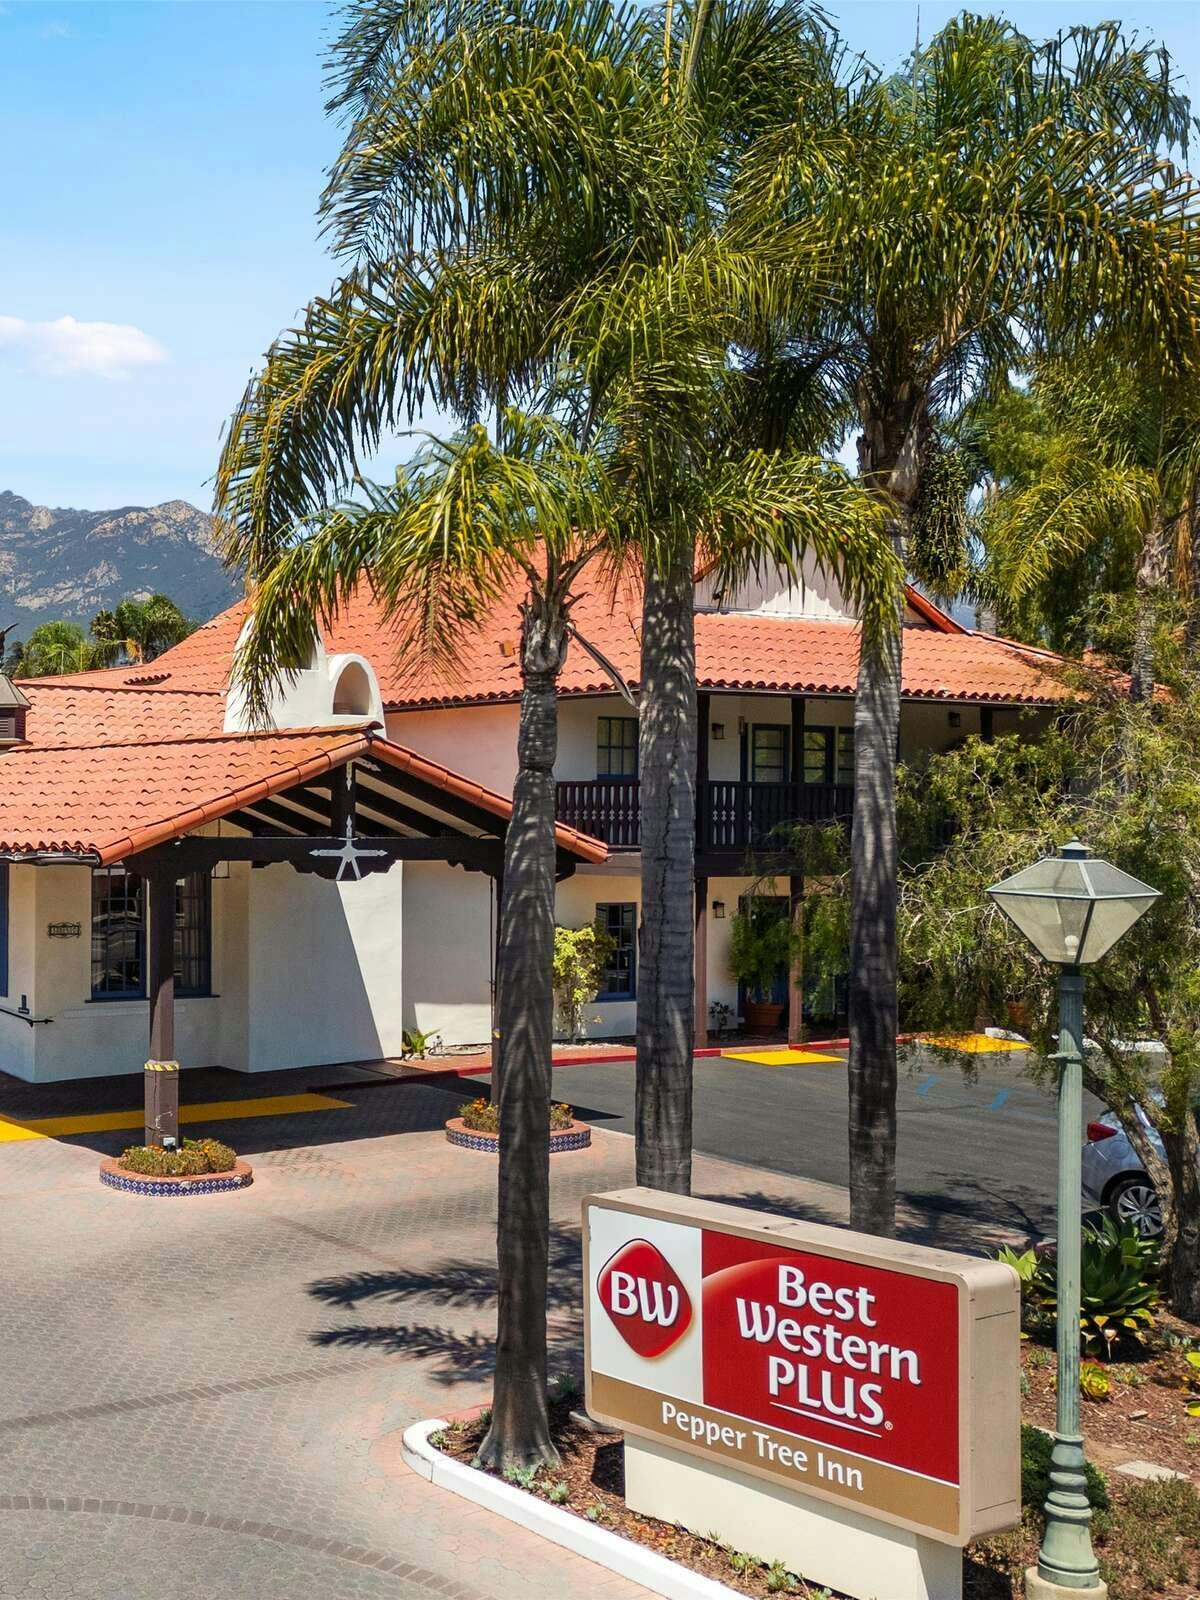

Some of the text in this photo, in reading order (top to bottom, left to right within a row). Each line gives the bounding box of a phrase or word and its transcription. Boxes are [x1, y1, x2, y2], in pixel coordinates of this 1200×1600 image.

[611, 1270, 679, 1327] BW
[778, 1264, 877, 1327] Best
[736, 1297, 922, 1385] Western
[661, 1401, 865, 1491] Pepper Tree Inn
